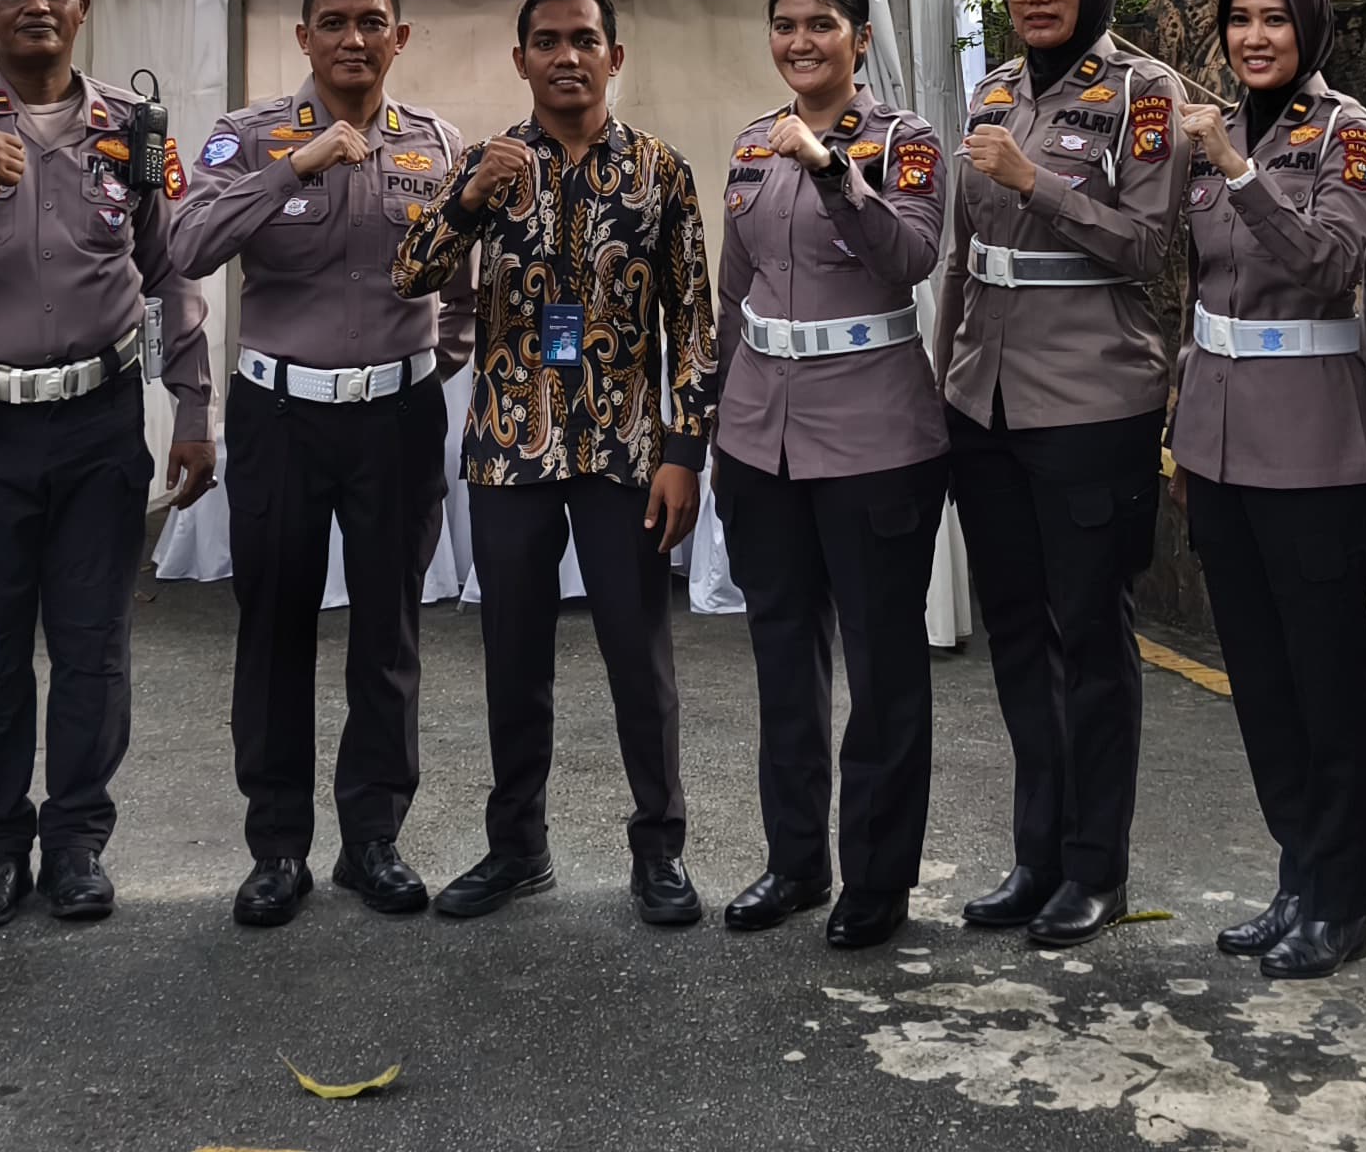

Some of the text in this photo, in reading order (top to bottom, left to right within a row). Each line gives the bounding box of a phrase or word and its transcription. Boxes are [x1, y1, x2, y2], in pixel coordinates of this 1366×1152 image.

[1051, 108, 1115, 134] POLRI
[1135, 112, 1164, 123] RIAU
[898, 143, 935, 155] POLDA
[1265, 151, 1316, 171] POLRI
